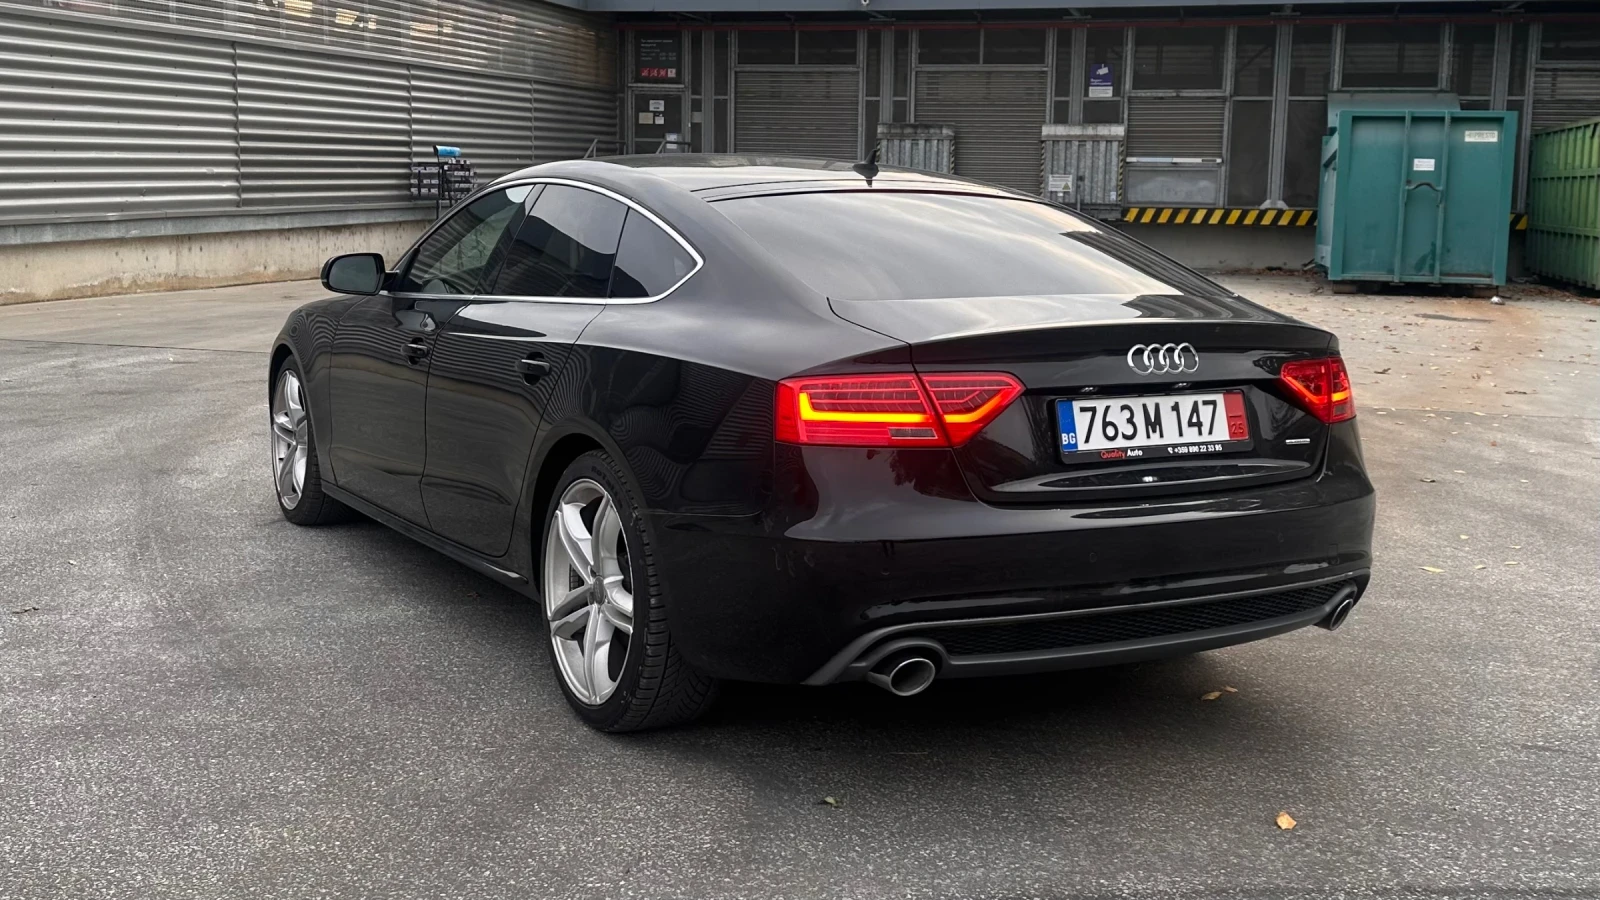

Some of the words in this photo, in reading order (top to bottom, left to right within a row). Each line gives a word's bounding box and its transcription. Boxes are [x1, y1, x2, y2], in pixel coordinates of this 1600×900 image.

[1079, 404, 1138, 444] 763
[1142, 401, 1164, 439] M
[1171, 399, 1218, 437] 147
[1230, 421, 1245, 435] 25
[1061, 433, 1076, 445] BG
[1100, 449, 1126, 459] Quality
[1126, 448, 1143, 457] Auto
